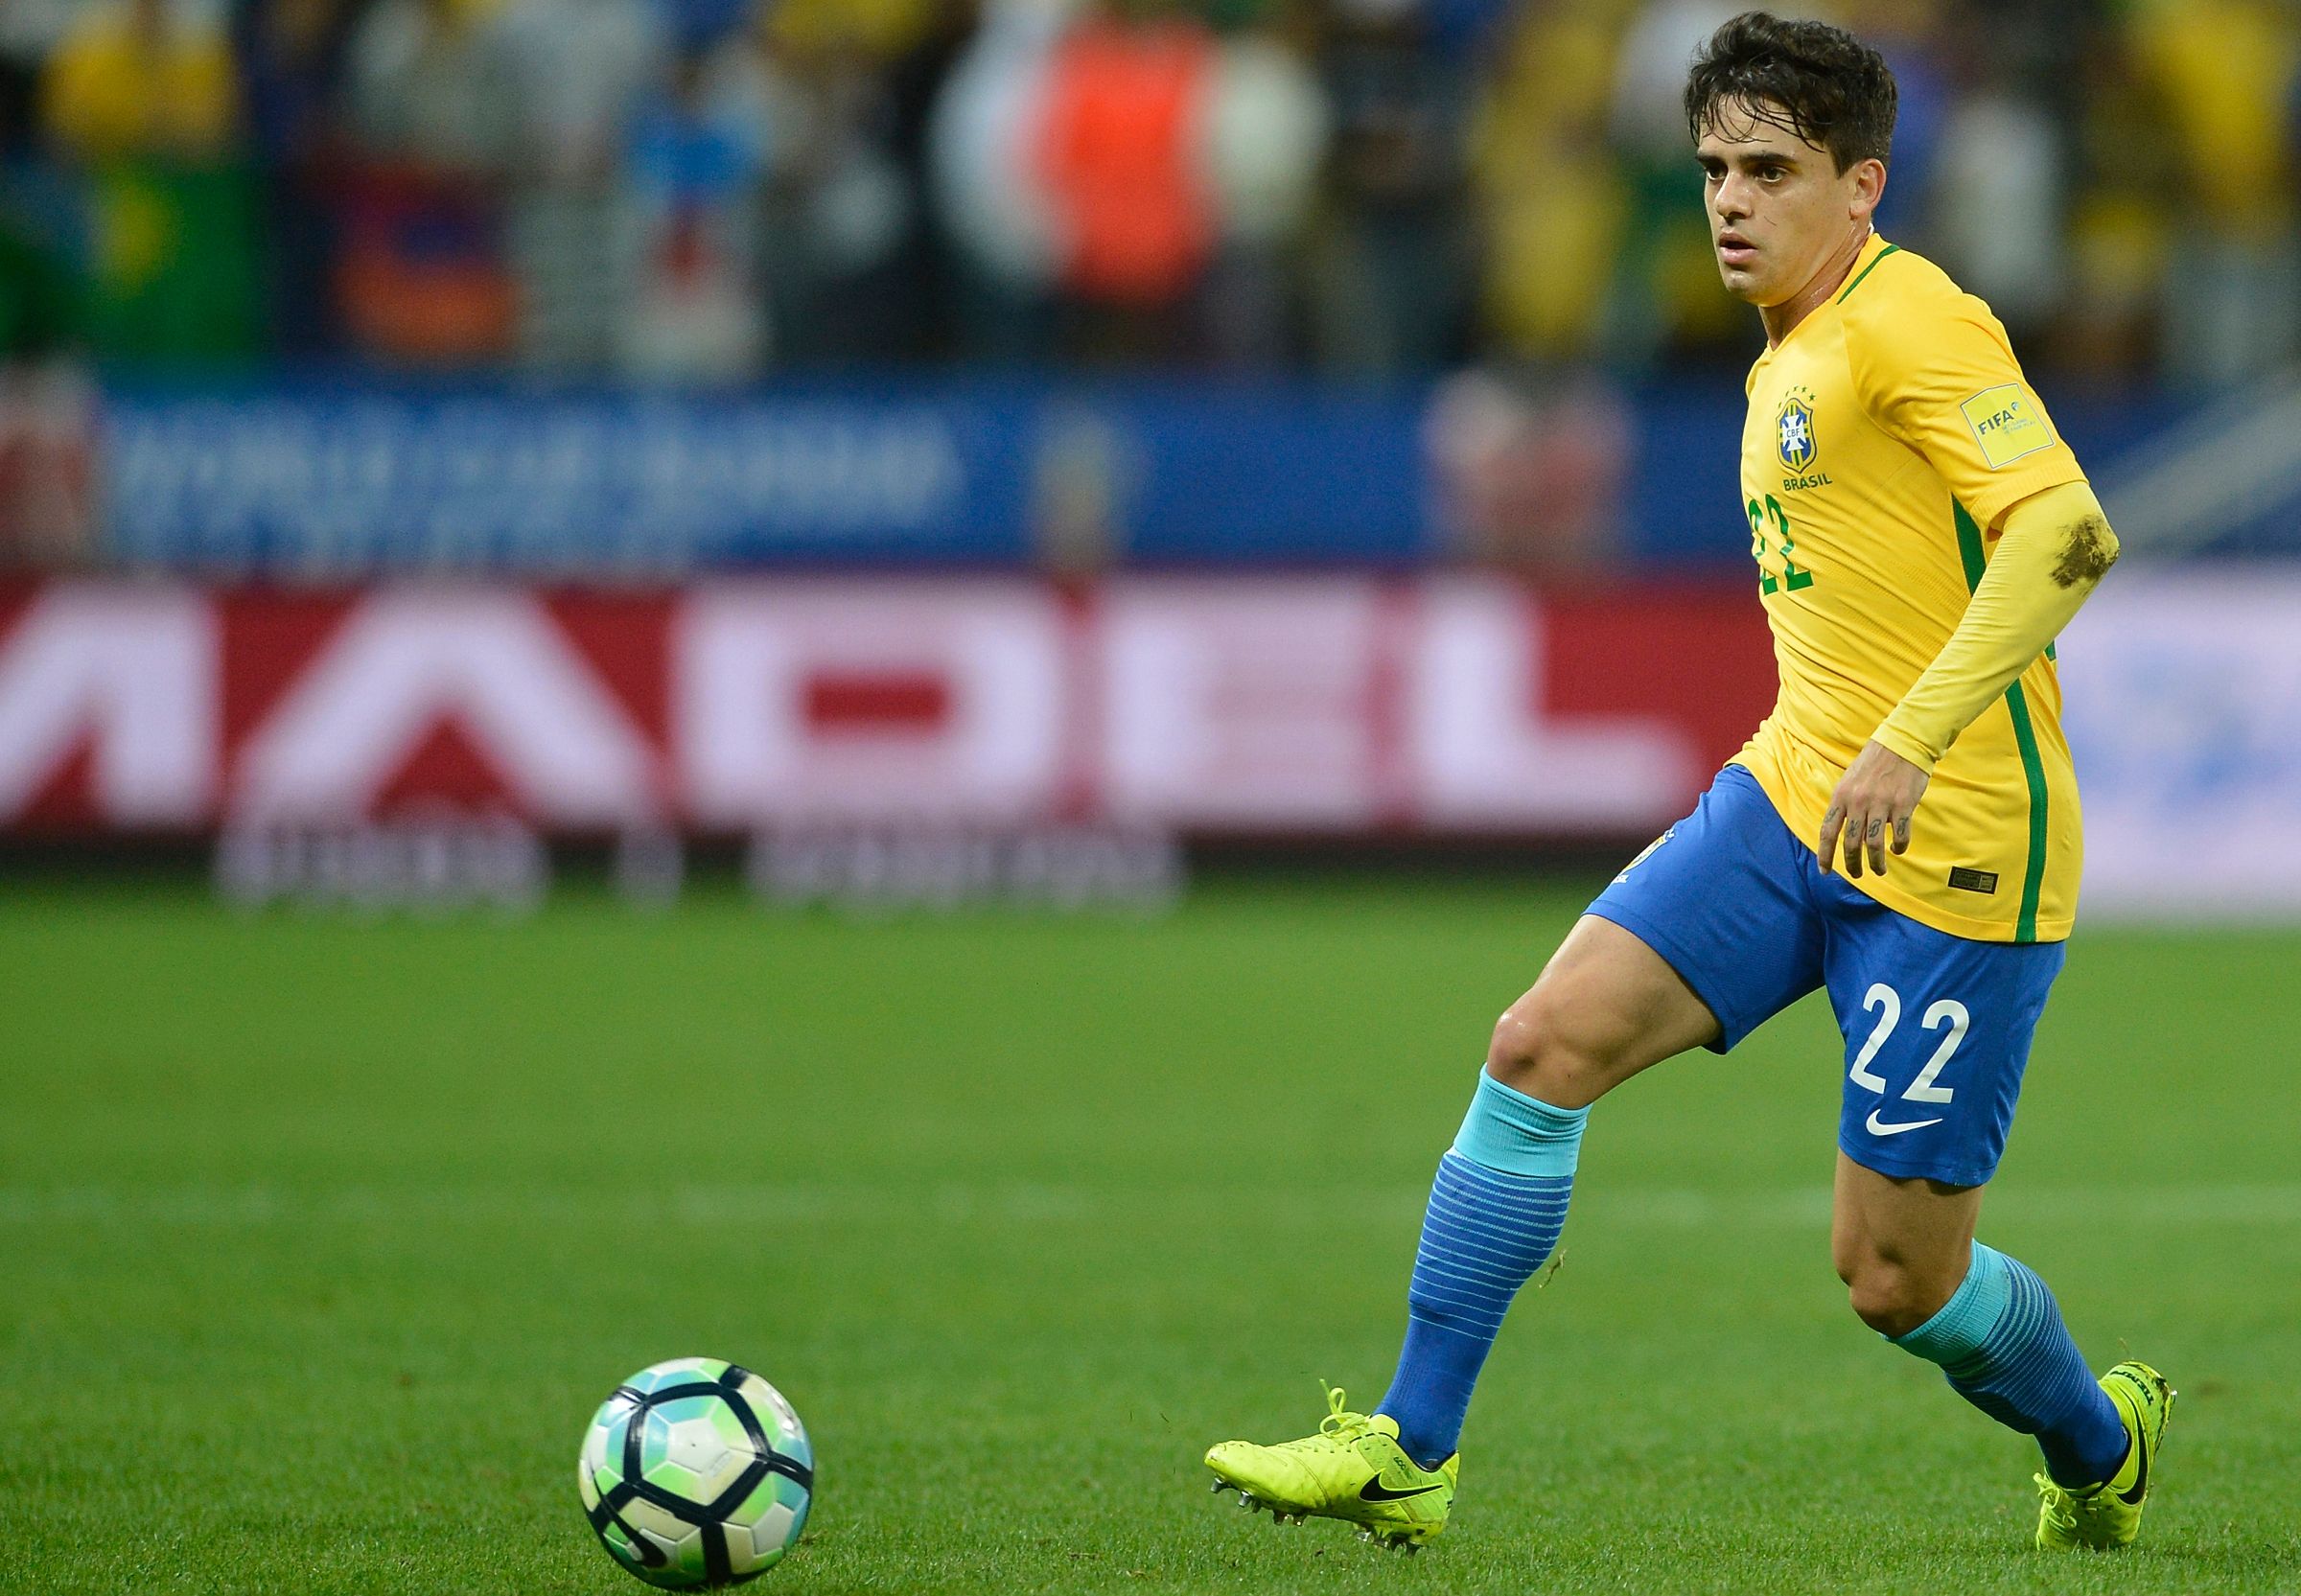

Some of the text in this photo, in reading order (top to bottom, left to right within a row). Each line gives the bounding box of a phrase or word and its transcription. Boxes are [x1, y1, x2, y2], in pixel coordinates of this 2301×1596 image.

[1786, 428, 1801, 438] CBF
[1978, 409, 2014, 435] FIFA
[1783, 473, 1833, 492] BRASIL
[1749, 493, 1814, 596] 22
[1849, 983, 1970, 1104] 22
[2109, 1371, 2154, 1406] TIEMP
